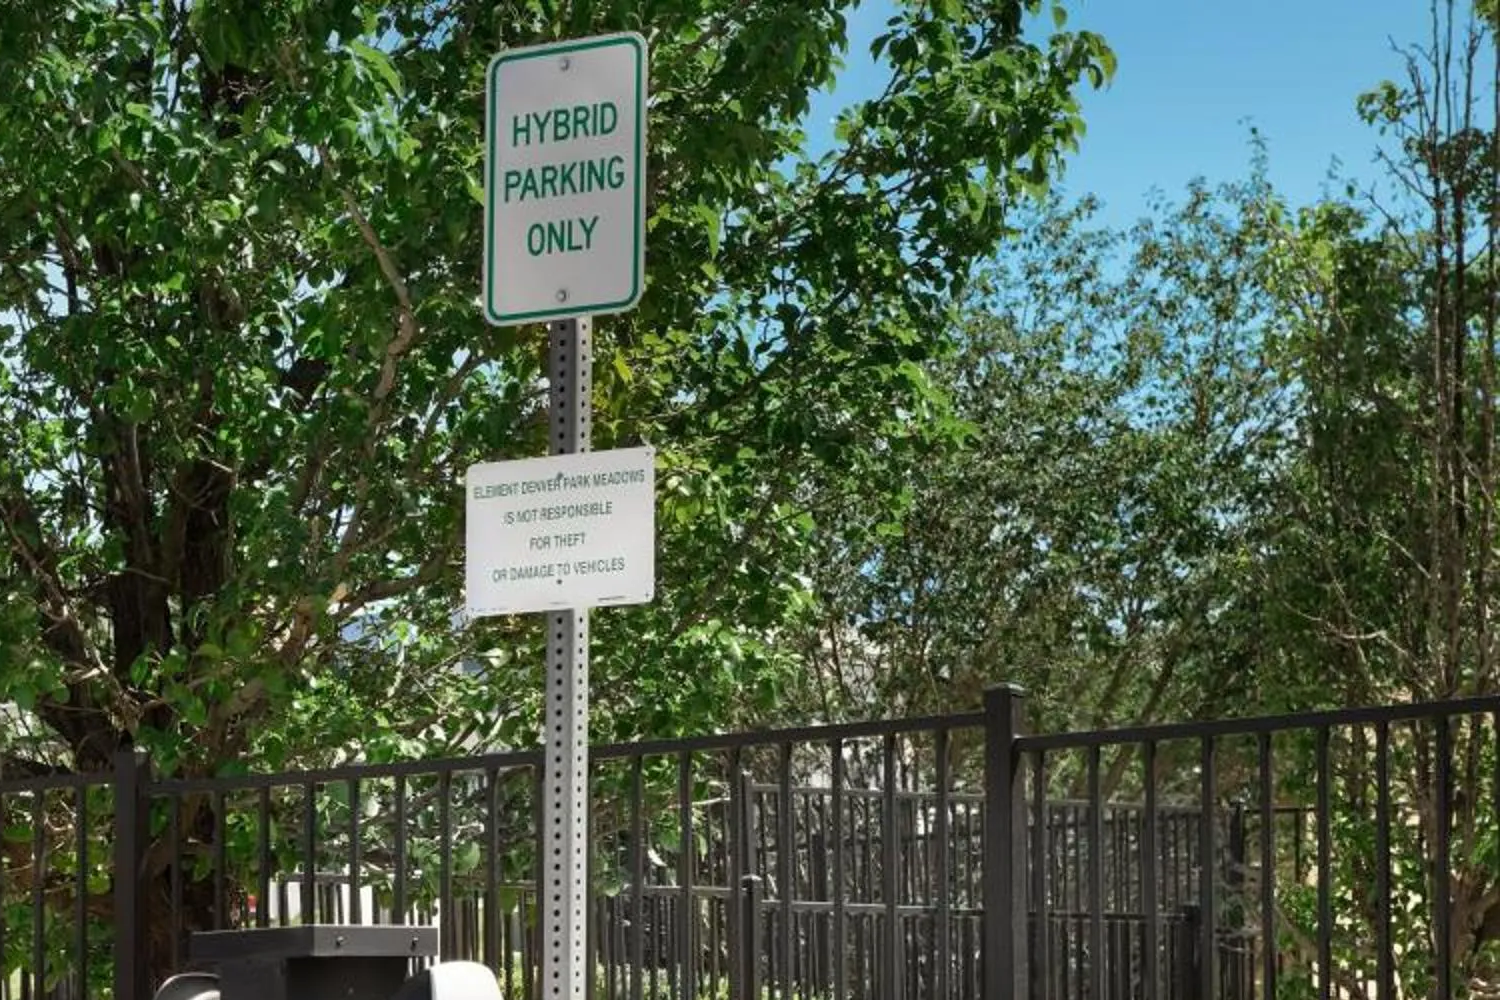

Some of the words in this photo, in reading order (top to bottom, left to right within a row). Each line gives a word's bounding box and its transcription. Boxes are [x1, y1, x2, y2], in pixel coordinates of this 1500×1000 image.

[513, 102, 618, 147] HYBRID
[504, 155, 625, 203] PARKING
[527, 216, 599, 257] ONLY
[473, 483, 519, 500] ELEMENT
[521, 479, 560, 495] DENVER
[563, 475, 590, 490] PARK
[593, 469, 645, 486] MEADOWS
[504, 511, 514, 524] IS
[517, 509, 538, 523] NOT
[540, 501, 613, 521] RESPONSIBLE
[530, 536, 551, 551] FOR
[554, 532, 586, 547] THEFT
[492, 569, 507, 582] OR
[509, 563, 554, 581] DAMAGE
[556, 562, 570, 576] TO
[573, 557, 625, 575] VEHICLES
